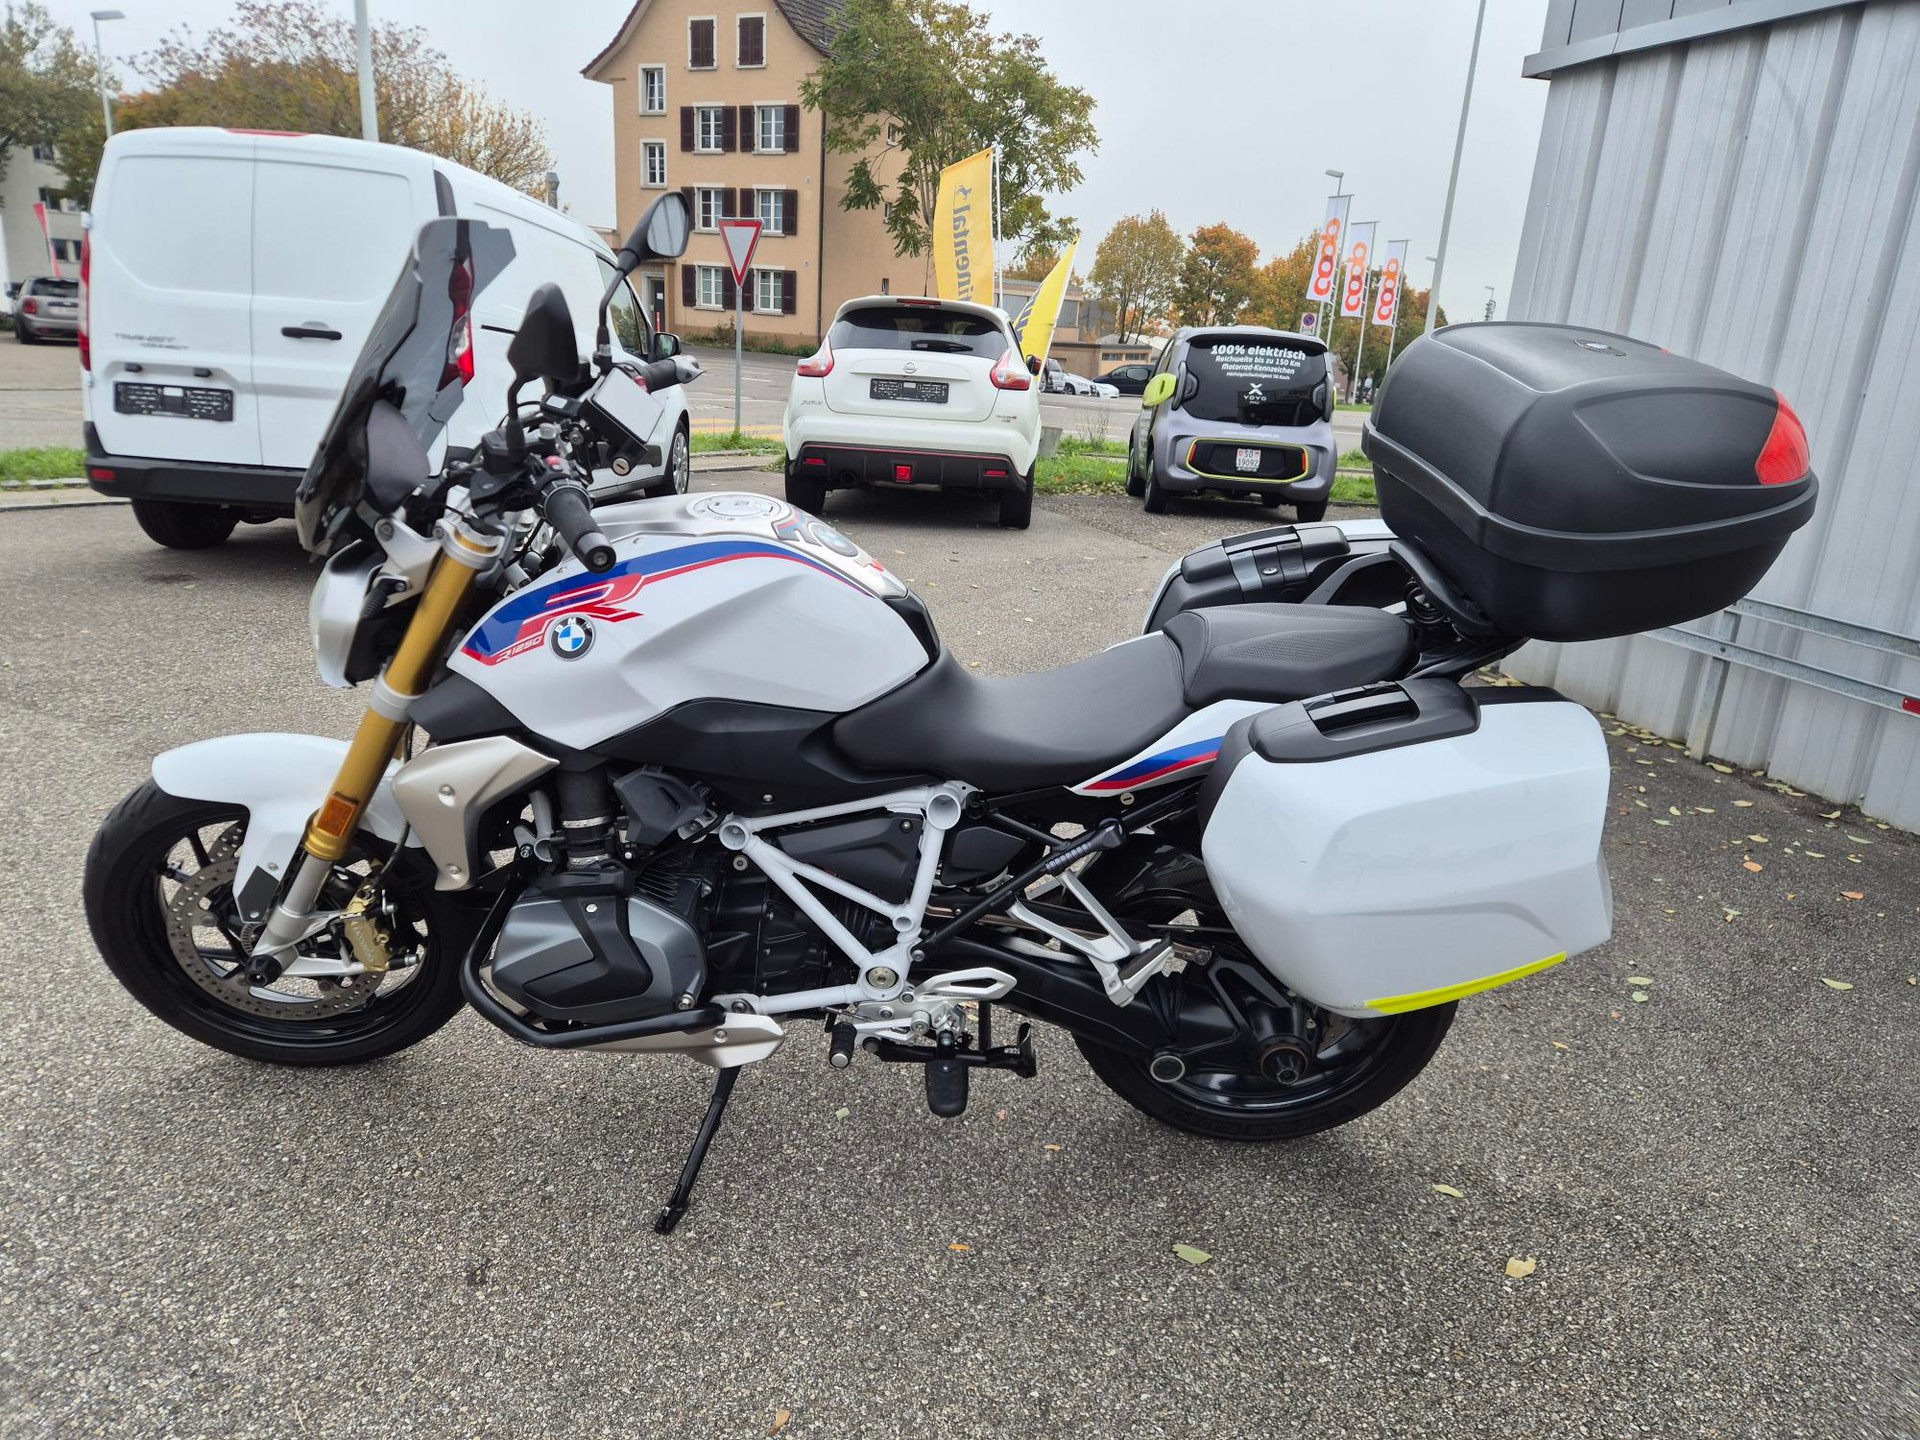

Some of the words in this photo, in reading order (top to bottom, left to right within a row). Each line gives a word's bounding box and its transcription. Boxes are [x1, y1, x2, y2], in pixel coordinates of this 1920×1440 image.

[1211, 345, 1245, 355] 100%
[1248, 346, 1306, 360] elektrisch
[1275, 358, 1288, 366] 150
[1222, 363, 1295, 374] Motorrad-Kennzeichen
[1238, 458, 1259, 467] 19092
